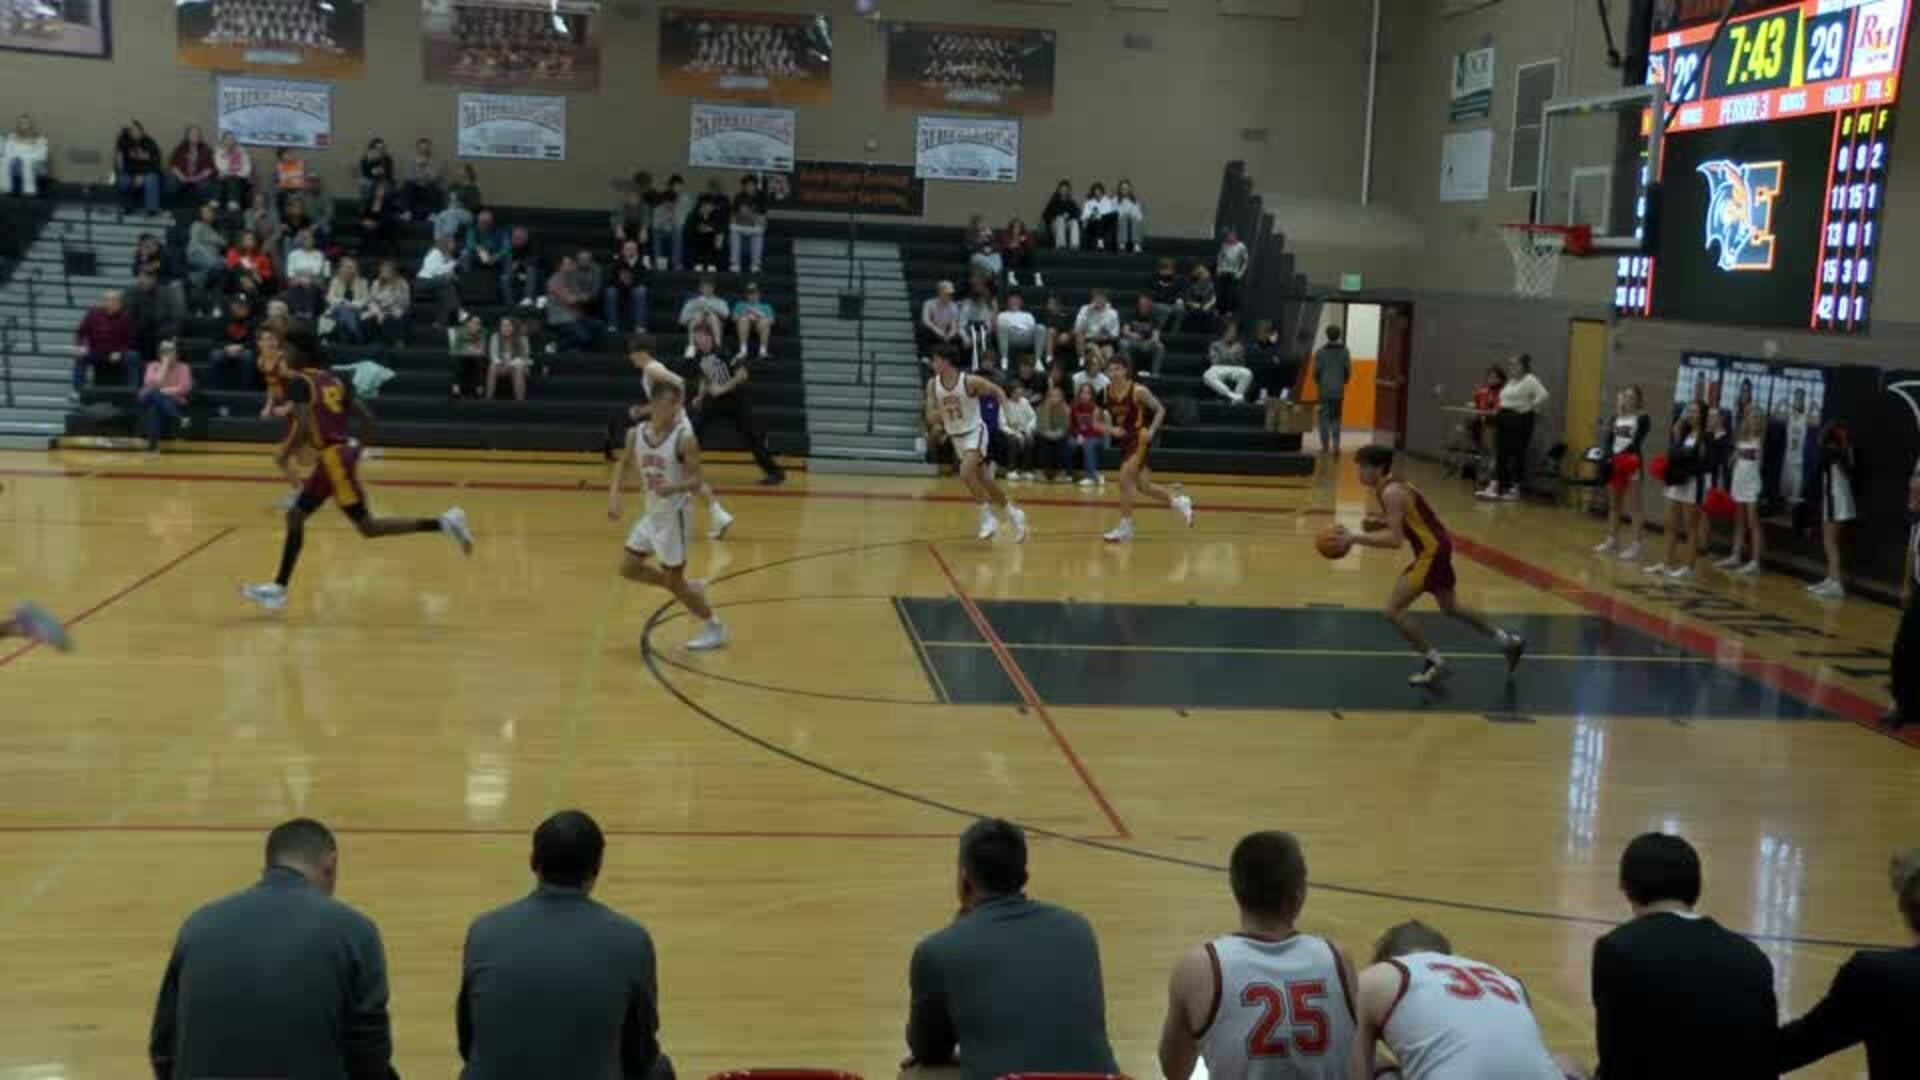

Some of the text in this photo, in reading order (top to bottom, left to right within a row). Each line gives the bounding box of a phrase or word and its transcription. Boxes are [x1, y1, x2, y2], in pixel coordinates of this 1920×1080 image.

[1726, 16, 1787, 85] 7:43
[1806, 21, 1843, 80] 29
[1824, 83, 1850, 106] FOULS
[1870, 142, 1883, 169] 2
[1831, 185, 1845, 211] 11
[1867, 183, 1877, 209] 1
[1863, 220, 1873, 247] 1
[1841, 258, 1853, 284] 3
[1857, 258, 1868, 284] 0
[1837, 295, 1849, 321] 0
[1854, 295, 1863, 321] 1
[1427, 960, 1521, 1004] 35
[1241, 980, 1333, 1059] 25
